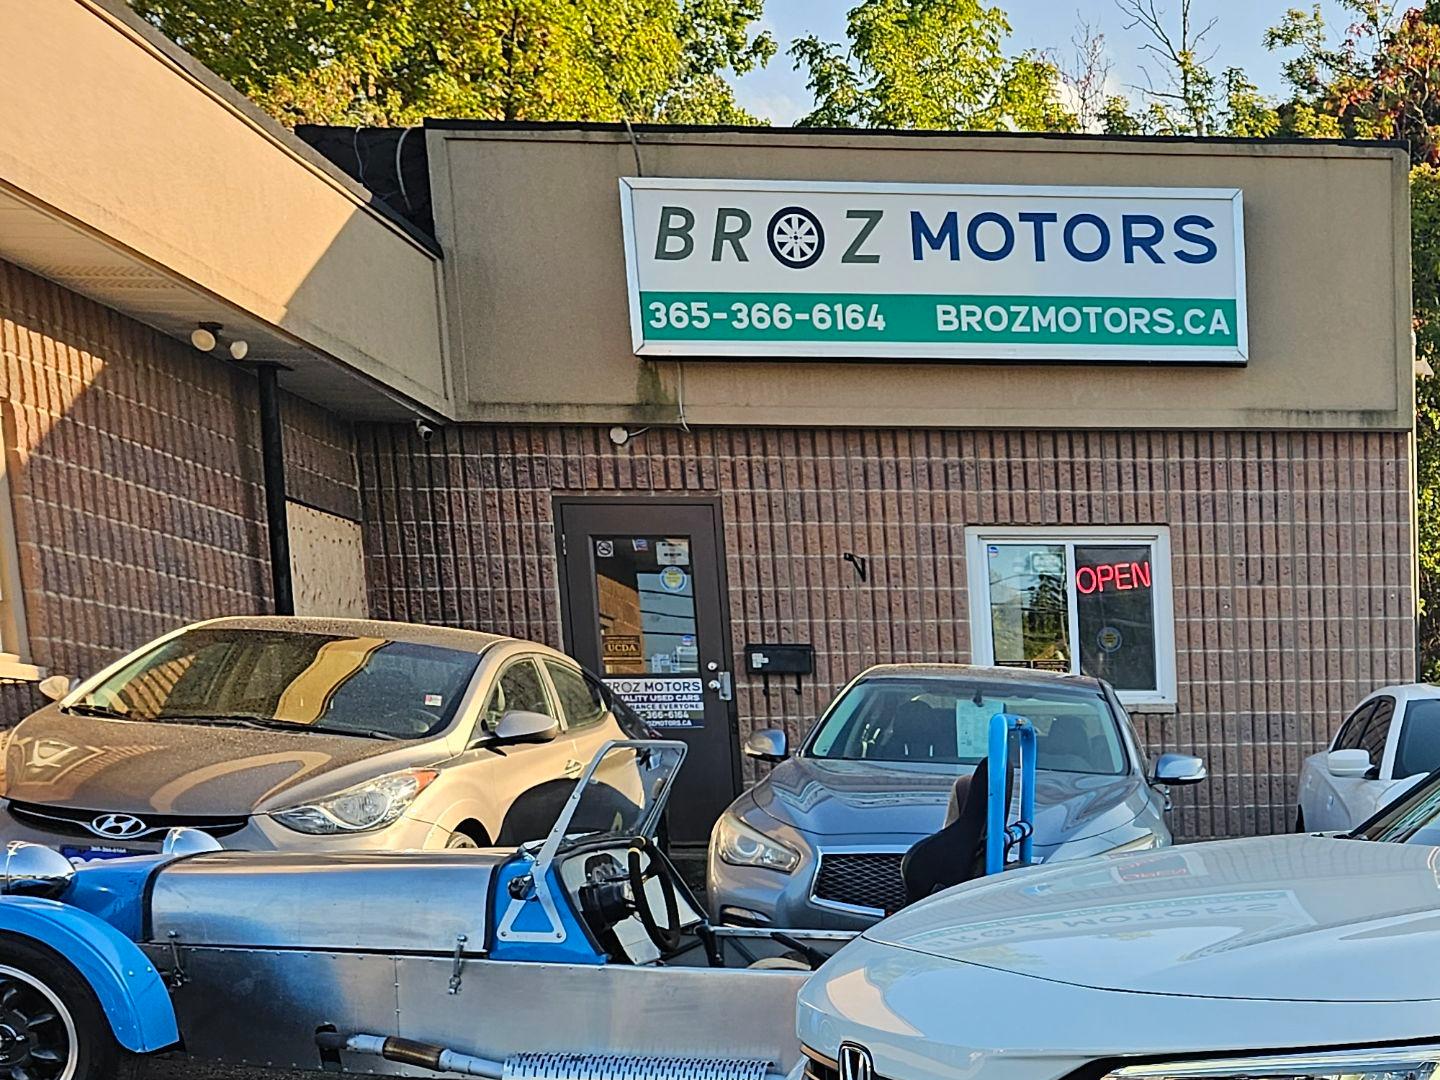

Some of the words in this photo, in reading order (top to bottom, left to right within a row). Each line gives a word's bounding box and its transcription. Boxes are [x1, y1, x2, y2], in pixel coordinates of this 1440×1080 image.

[654, 206, 884, 268] BROZ
[911, 210, 1218, 264] MOTORS
[648, 302, 887, 332] 365-366-6164
[936, 304, 1231, 337] BROZMOTORS.CA
[1075, 561, 1152, 594] OPEN
[607, 643, 637, 652] UCDA
[644, 681, 701, 692] MOTORS
[621, 694, 648, 702] ALITY
[649, 694, 675, 702] USED
[676, 694, 700, 702] CARS
